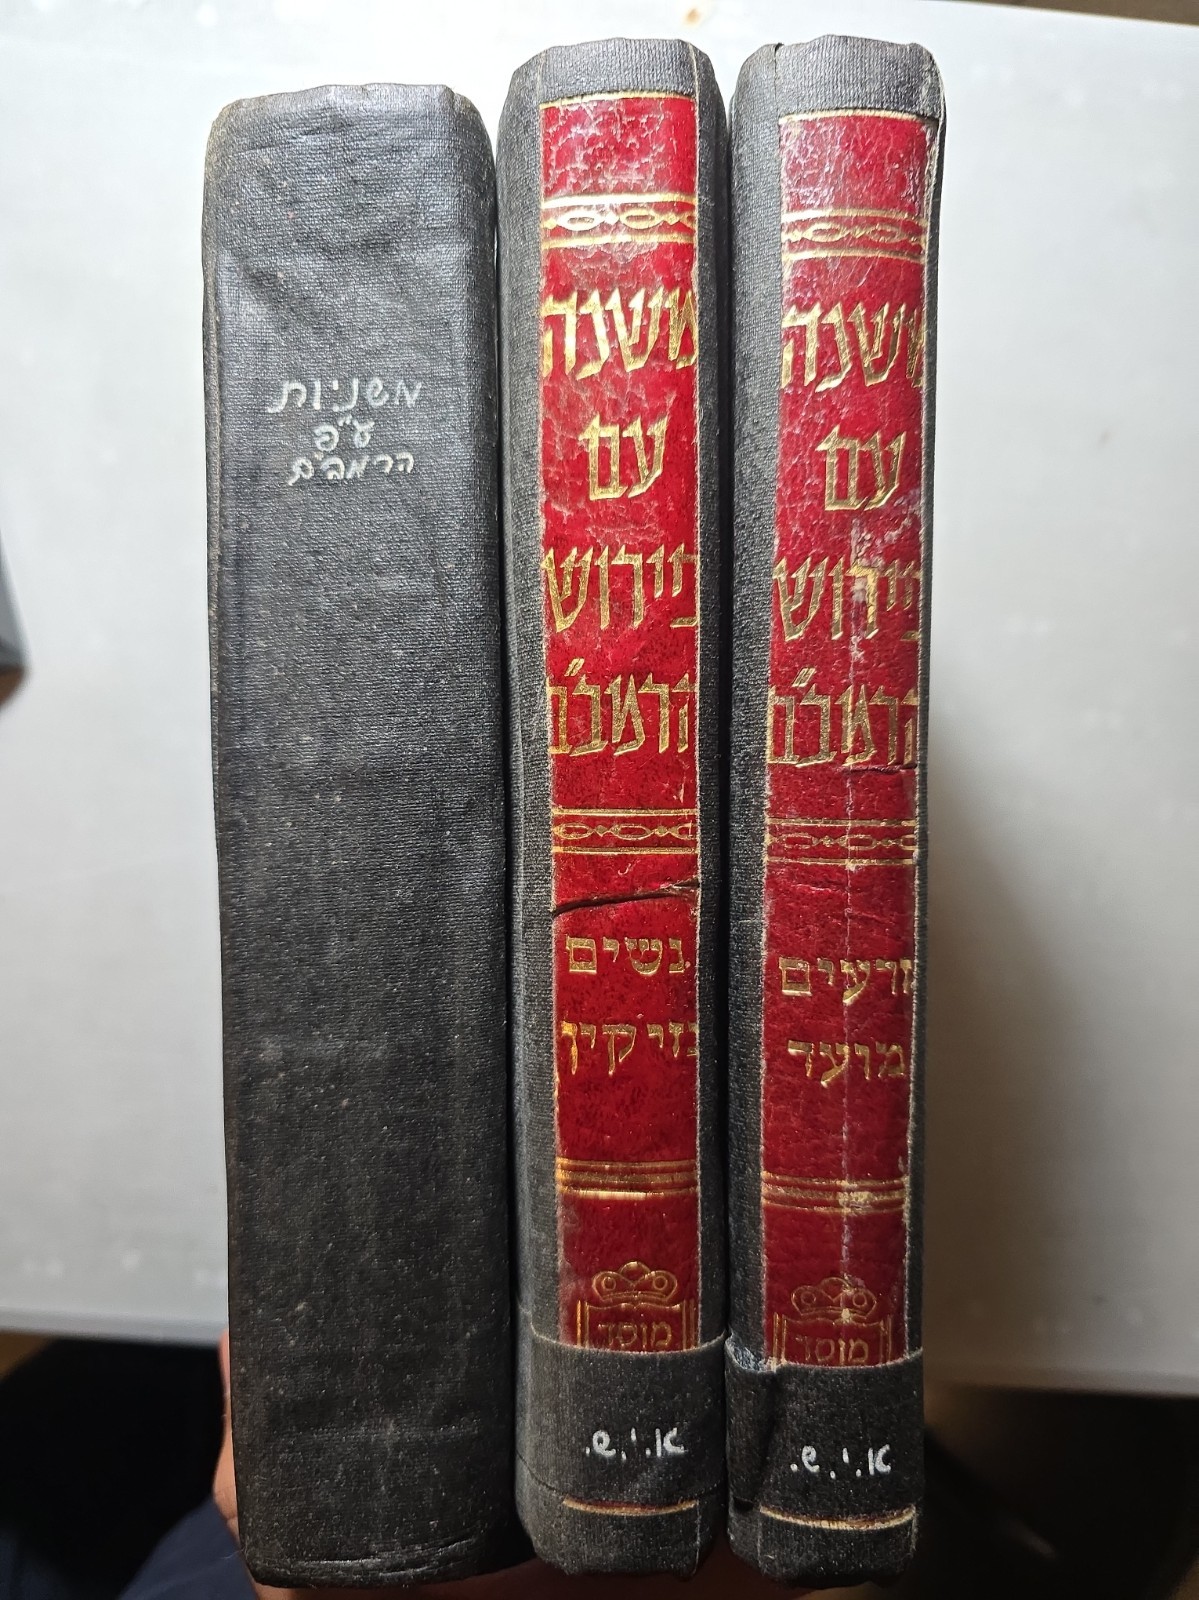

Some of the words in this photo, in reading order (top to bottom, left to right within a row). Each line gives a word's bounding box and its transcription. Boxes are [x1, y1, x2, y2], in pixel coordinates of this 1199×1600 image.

[541, 286, 698, 381] משנה
[267, 376, 422, 414] משניות
[578, 415, 669, 501] עם
[815, 424, 906, 511] עם
[565, 933, 685, 976] נשים
[778, 957, 912, 1006] זרעים
[787, 1039, 906, 1089] מועד
[597, 1320, 673, 1352] מוסד
